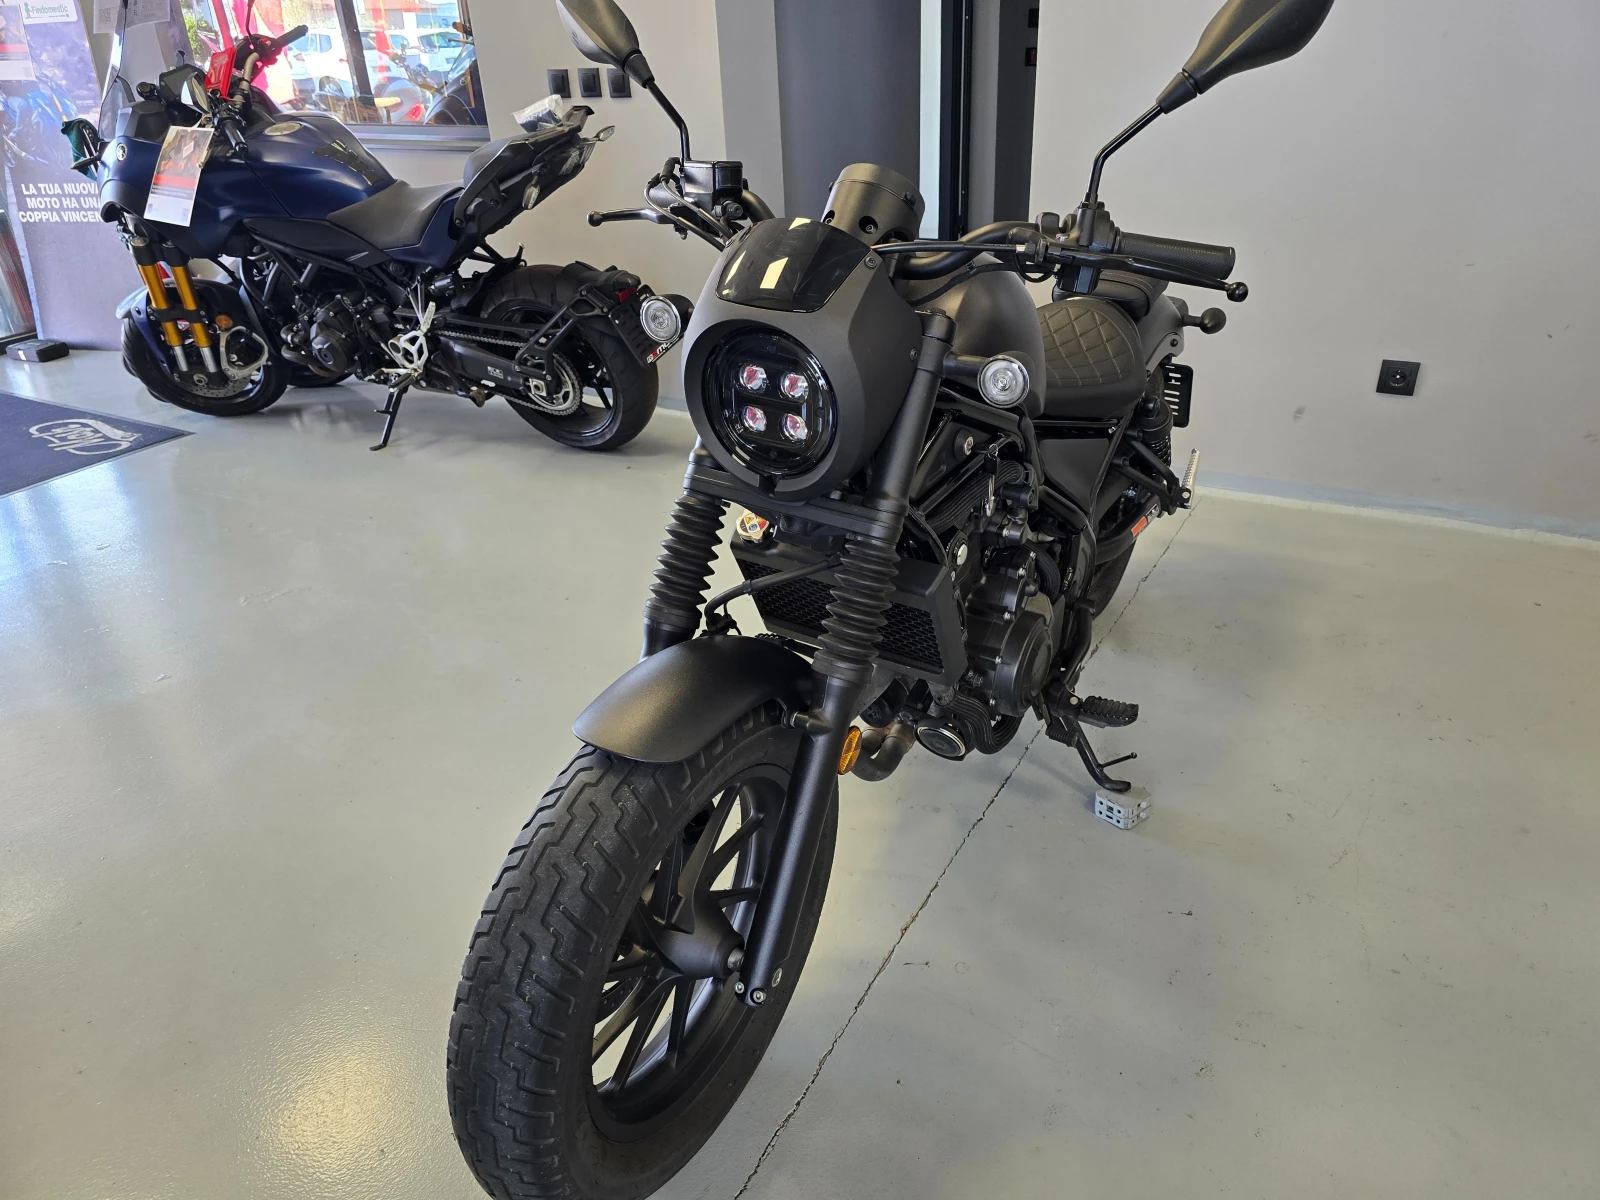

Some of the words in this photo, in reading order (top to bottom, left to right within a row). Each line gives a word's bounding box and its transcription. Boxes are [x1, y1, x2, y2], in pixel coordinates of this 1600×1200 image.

[31, 4, 69, 15] Findomestic
[21, 183, 38, 195] LA
[38, 183, 63, 195] TUA
[26, 197, 61, 209] MOTO
[61, 197, 80, 209] HA
[19, 211, 61, 223] COPPIA
